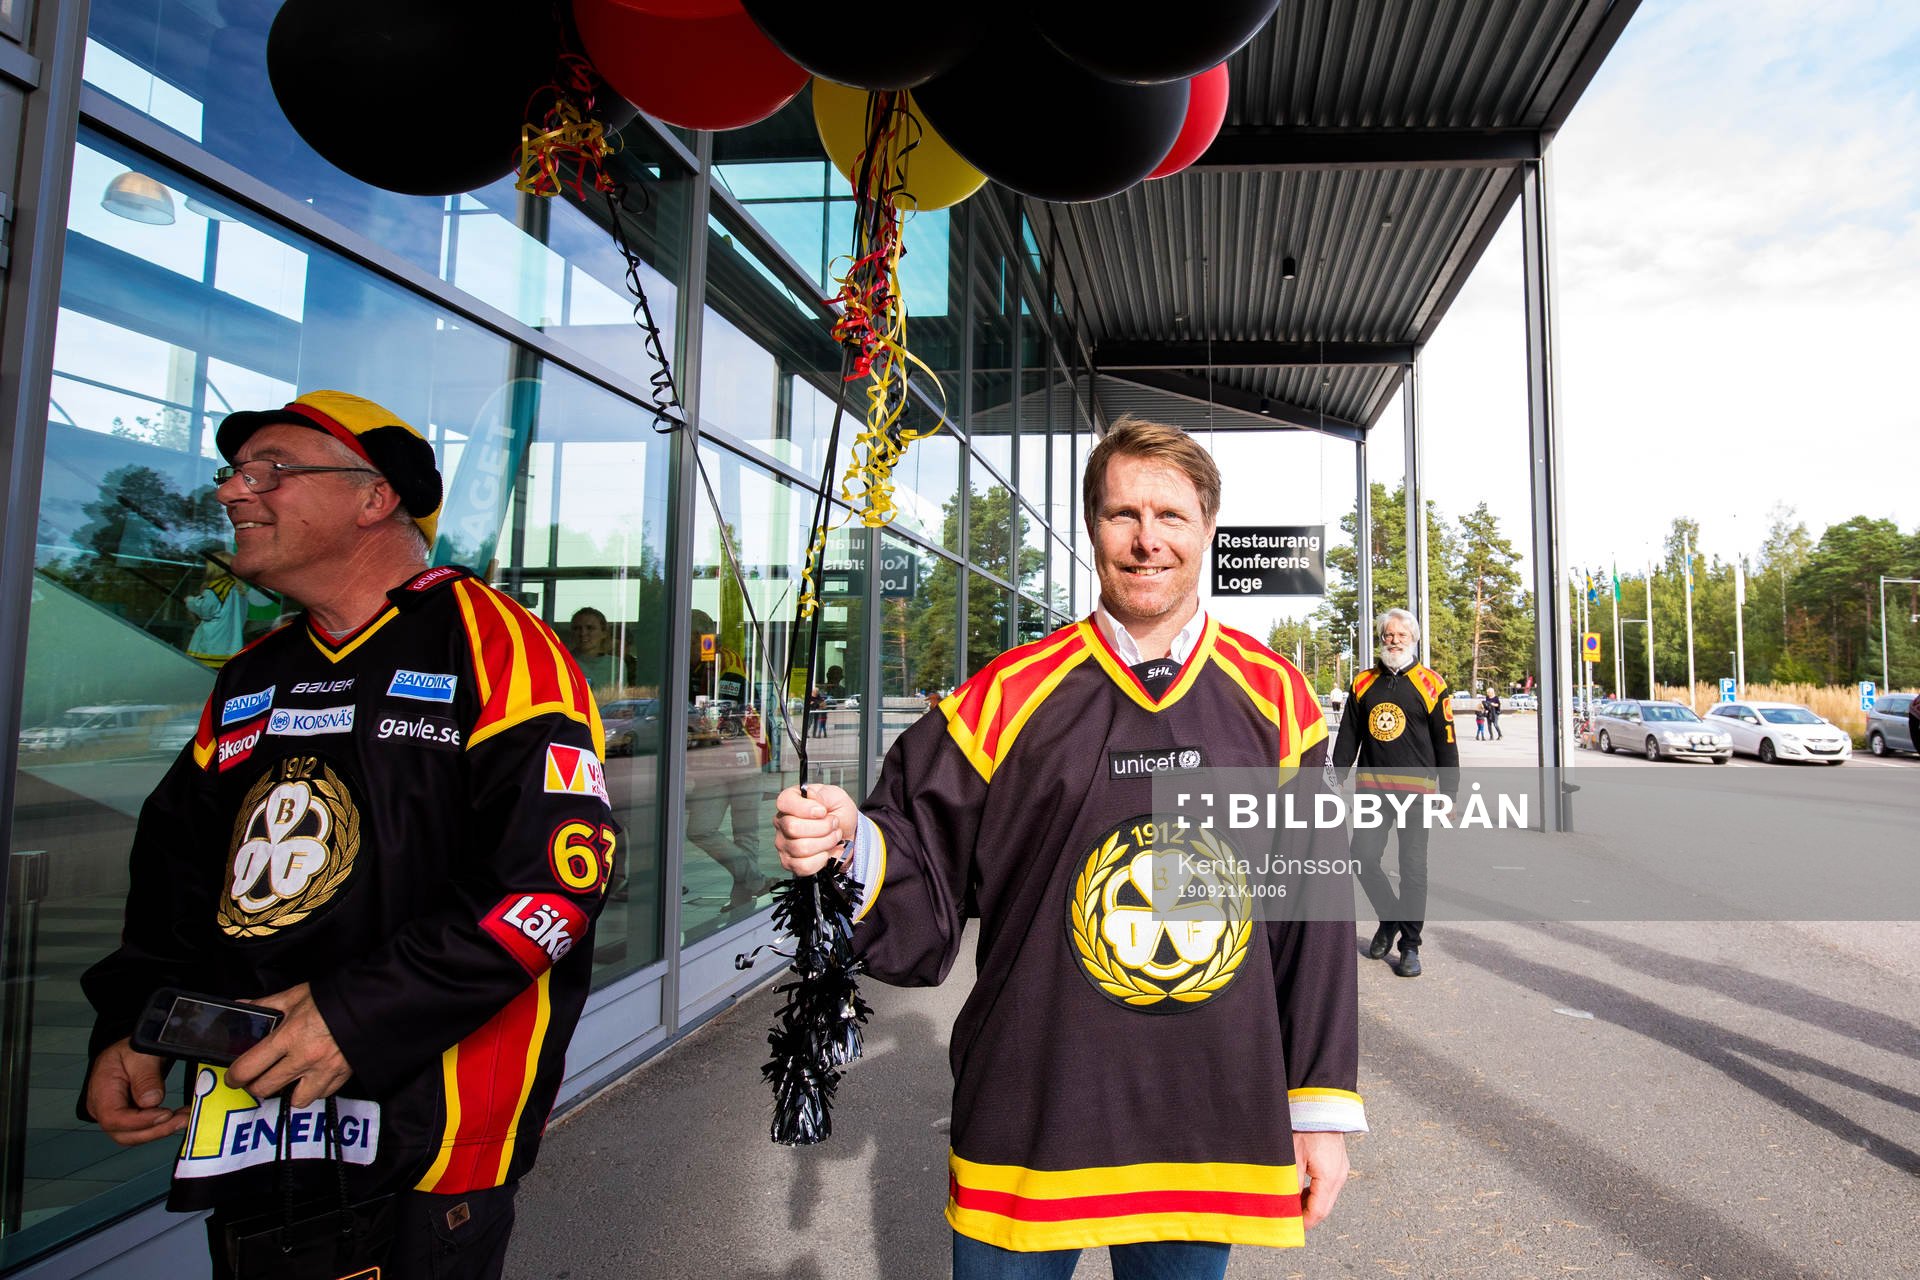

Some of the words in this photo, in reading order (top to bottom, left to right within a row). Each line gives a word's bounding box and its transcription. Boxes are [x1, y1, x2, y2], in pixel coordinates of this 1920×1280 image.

[1217, 533, 1320, 552] Restaurang
[1217, 553, 1310, 569] Konferens
[1217, 574, 1263, 594] Loge
[395, 672, 452, 690] SANDVIK
[1147, 666, 1173, 679] SHL
[290, 678, 356, 694] BAUER
[1723, 679, 1733, 692] P
[225, 687, 273, 712] SANDVIK
[292, 709, 353, 731] KORSNÄS
[281, 756, 318, 780] 1912
[1114, 751, 1176, 774] unicef
[275, 798, 296, 825] B
[1131, 821, 1185, 847] 1912
